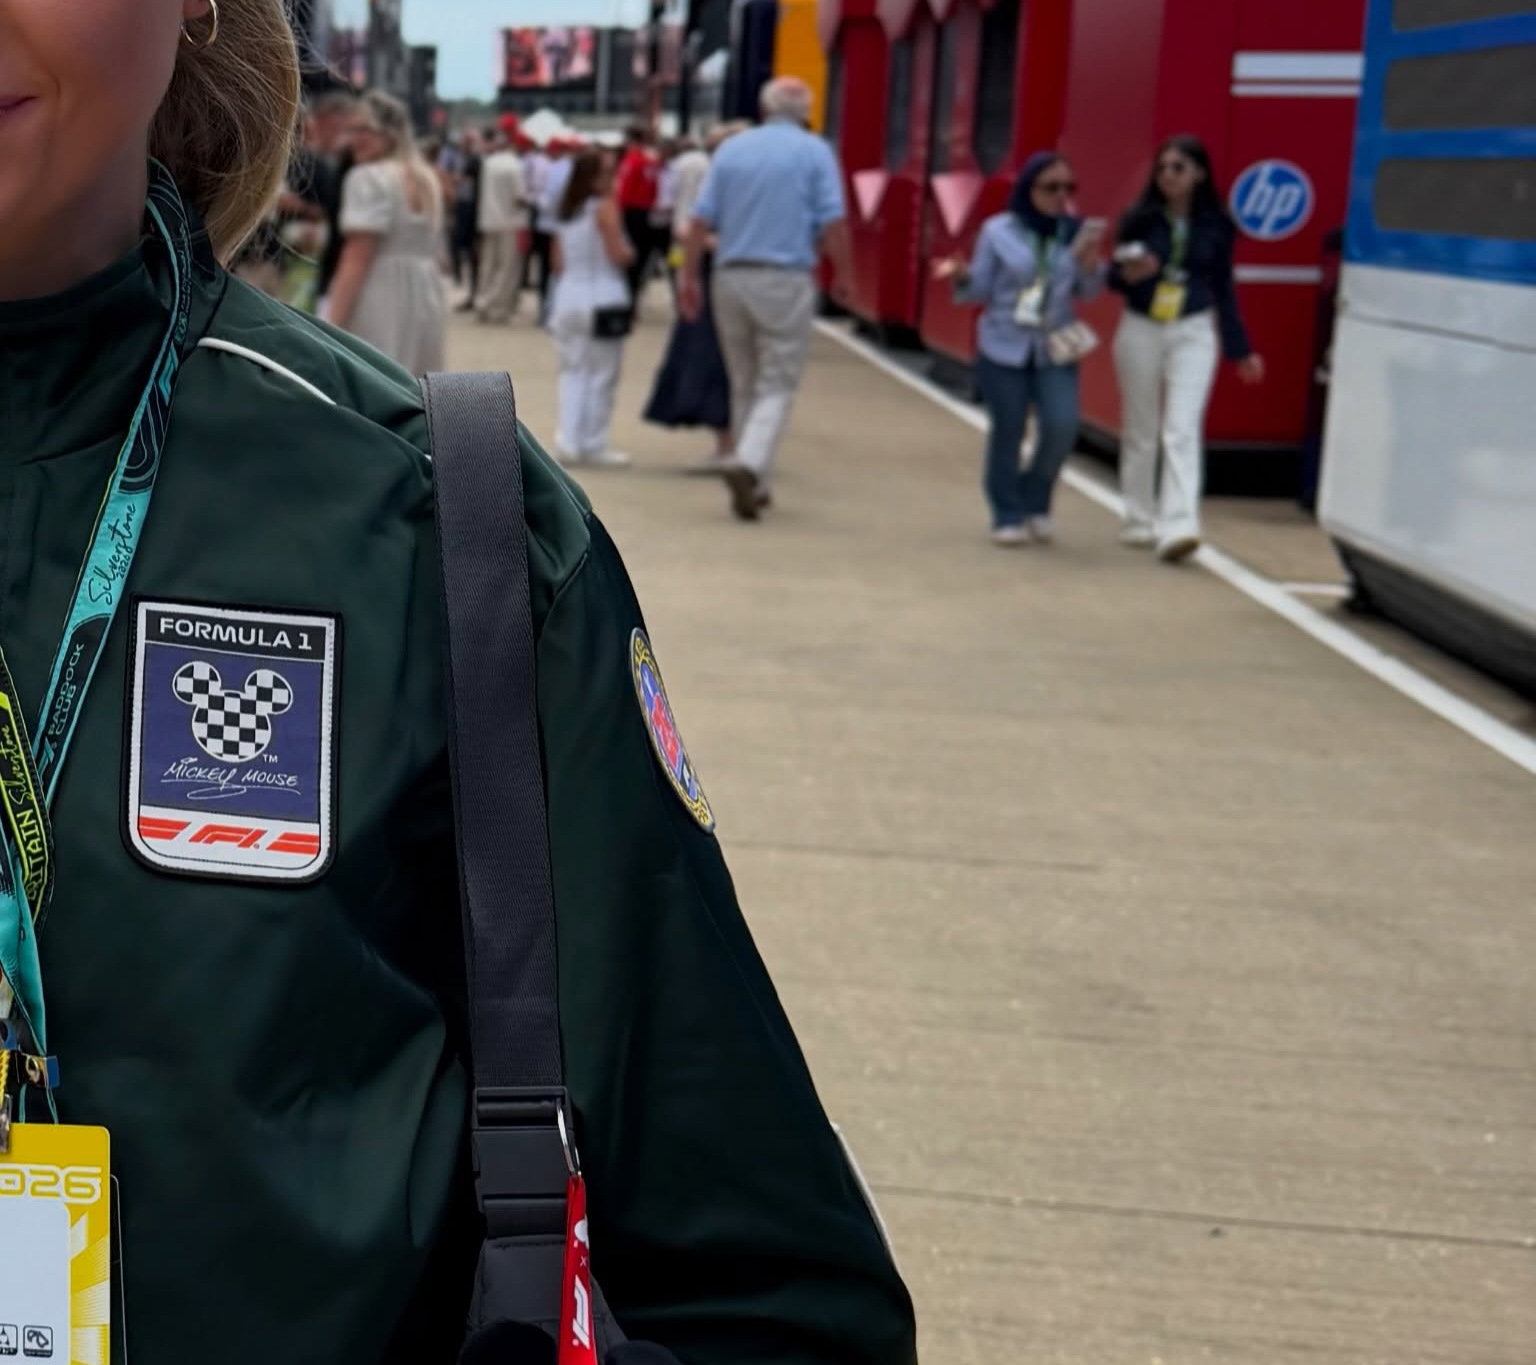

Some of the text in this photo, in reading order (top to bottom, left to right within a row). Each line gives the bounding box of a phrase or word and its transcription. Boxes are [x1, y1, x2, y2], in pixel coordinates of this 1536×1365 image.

[88, 502, 137, 606] Silverstone
[159, 617, 312, 651] FORMULA 1
[48, 642, 85, 736] PADDOCK
[55, 684, 76, 736] CLUB
[263, 753, 278, 764] TM
